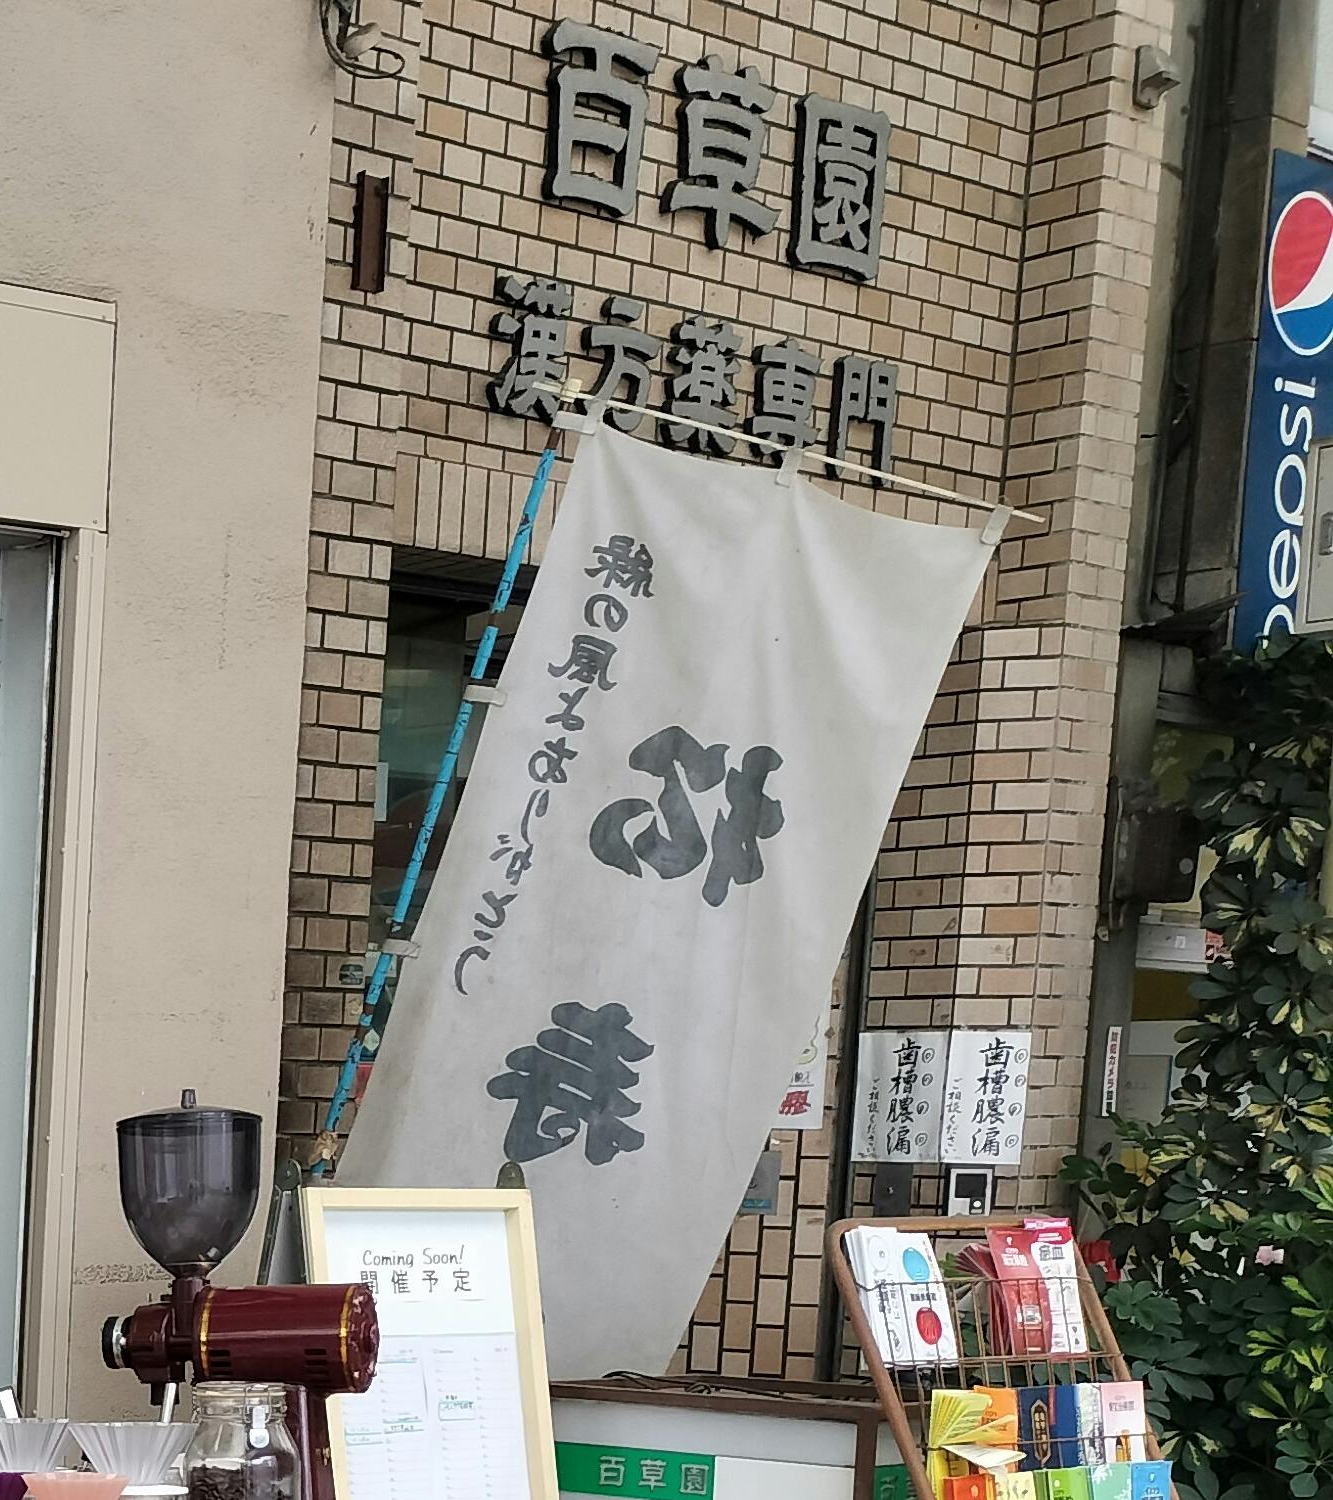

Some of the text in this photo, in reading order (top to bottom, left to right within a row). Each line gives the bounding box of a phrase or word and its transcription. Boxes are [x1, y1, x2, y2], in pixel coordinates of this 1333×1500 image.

[542, 18, 891, 282] 百草園
[486, 276, 897, 487] 漢方薬専門
[886, 1037, 922, 1156] 歯槽膿漏
[972, 1037, 1015, 1157] 歯槽膿漏
[360, 1268, 472, 1294] 開催予定
[362, 1244, 464, 1267] Coming Soon!
[597, 1455, 710, 1496] 百草園
